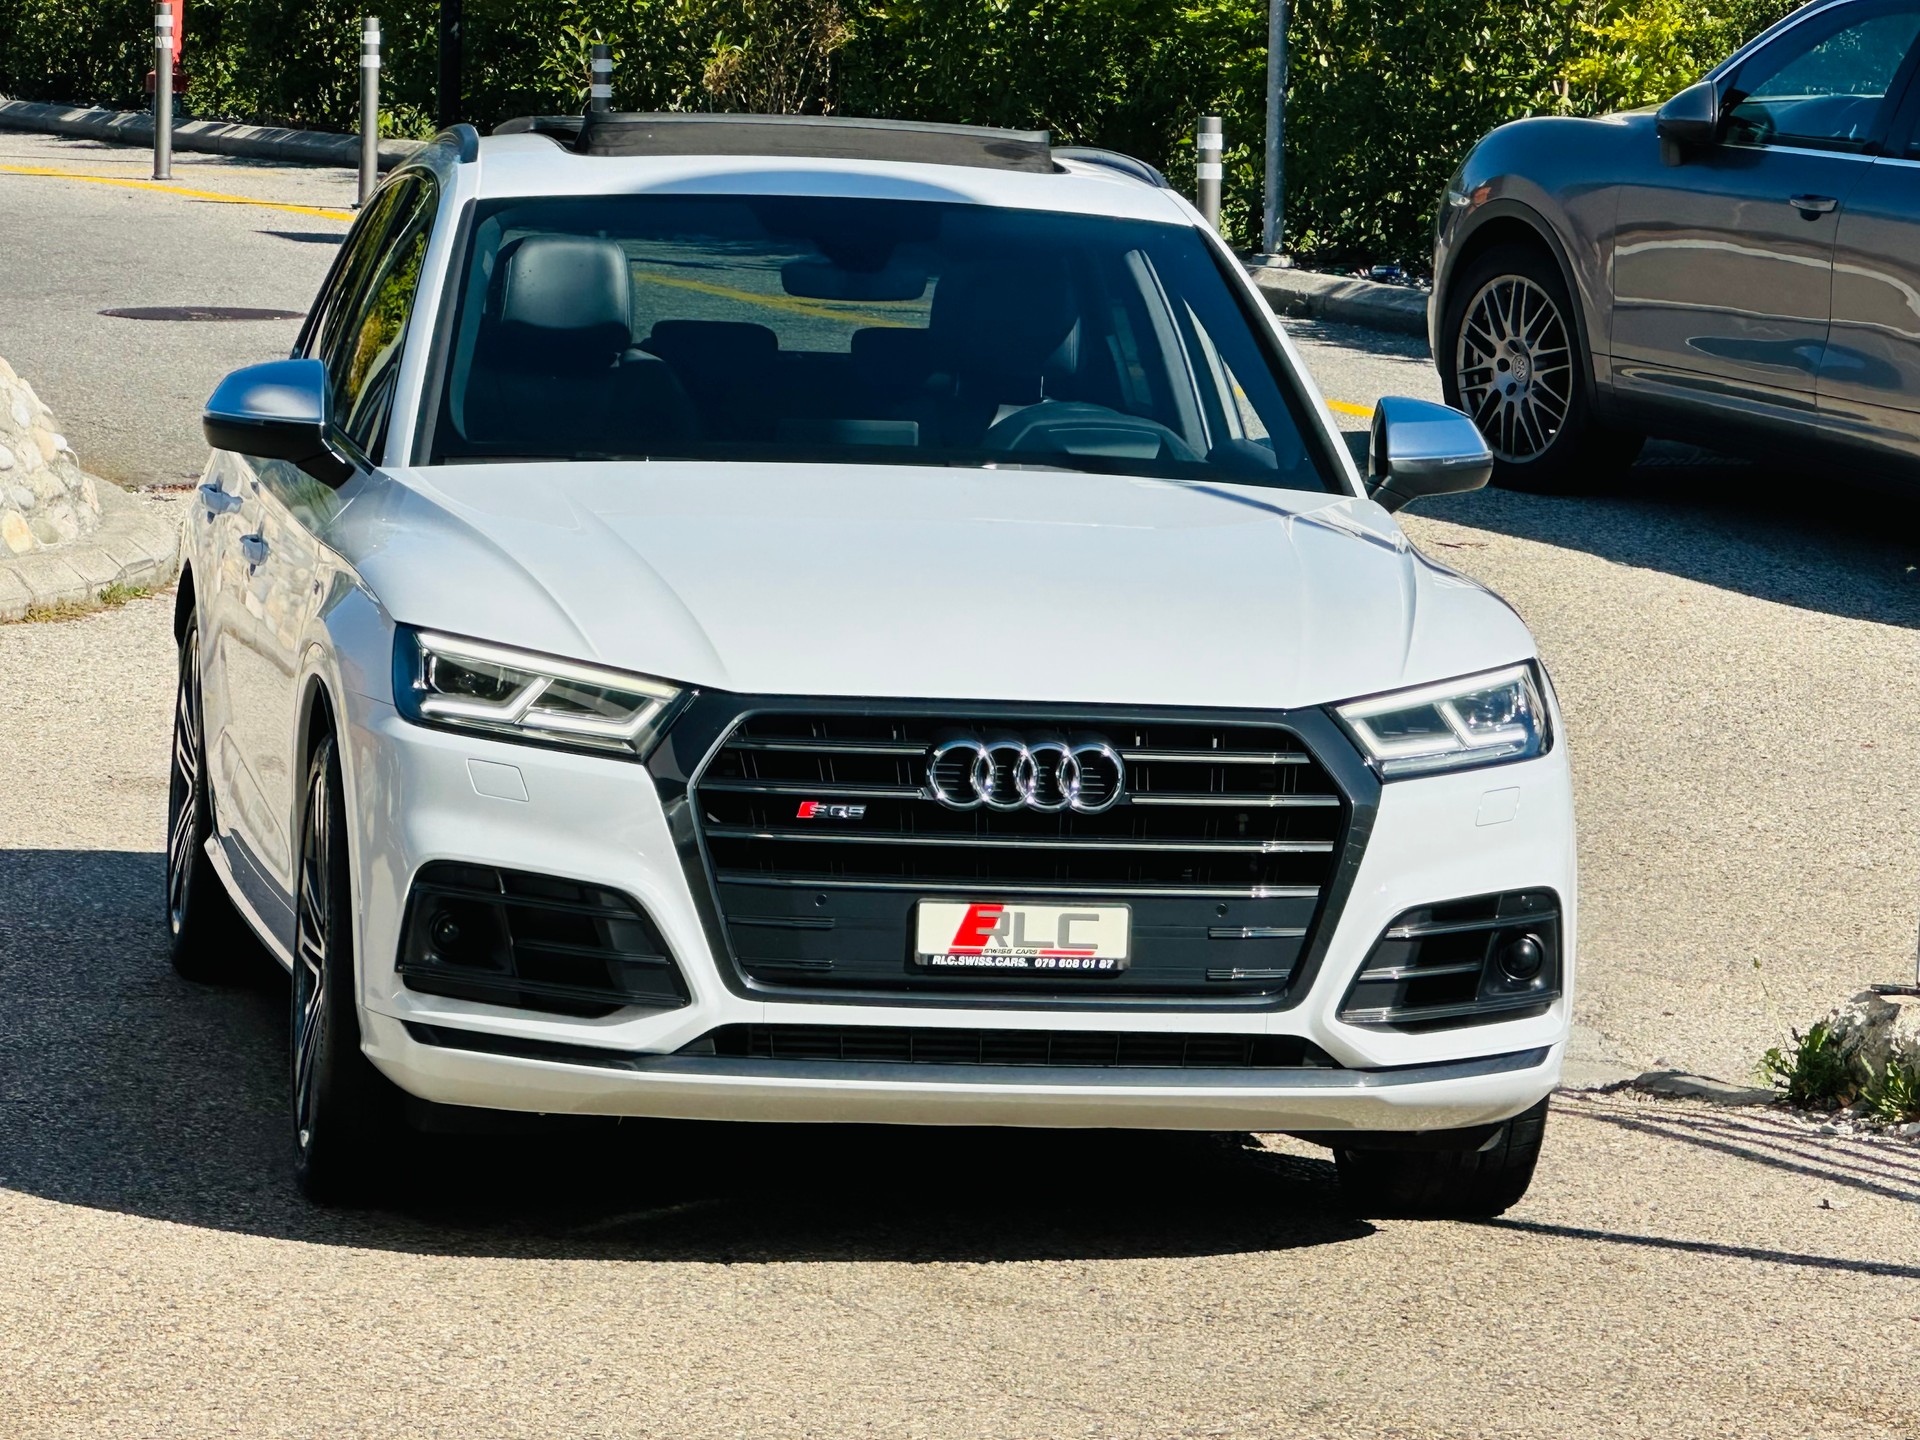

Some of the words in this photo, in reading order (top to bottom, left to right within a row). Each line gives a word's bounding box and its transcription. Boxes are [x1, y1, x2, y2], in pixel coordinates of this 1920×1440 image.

[808, 803, 867, 819] SQ5
[975, 910, 1100, 950] RLC
[1034, 958, 1057, 969] 079
[1082, 959, 1097, 969] 01
[1098, 959, 1115, 970] 87
